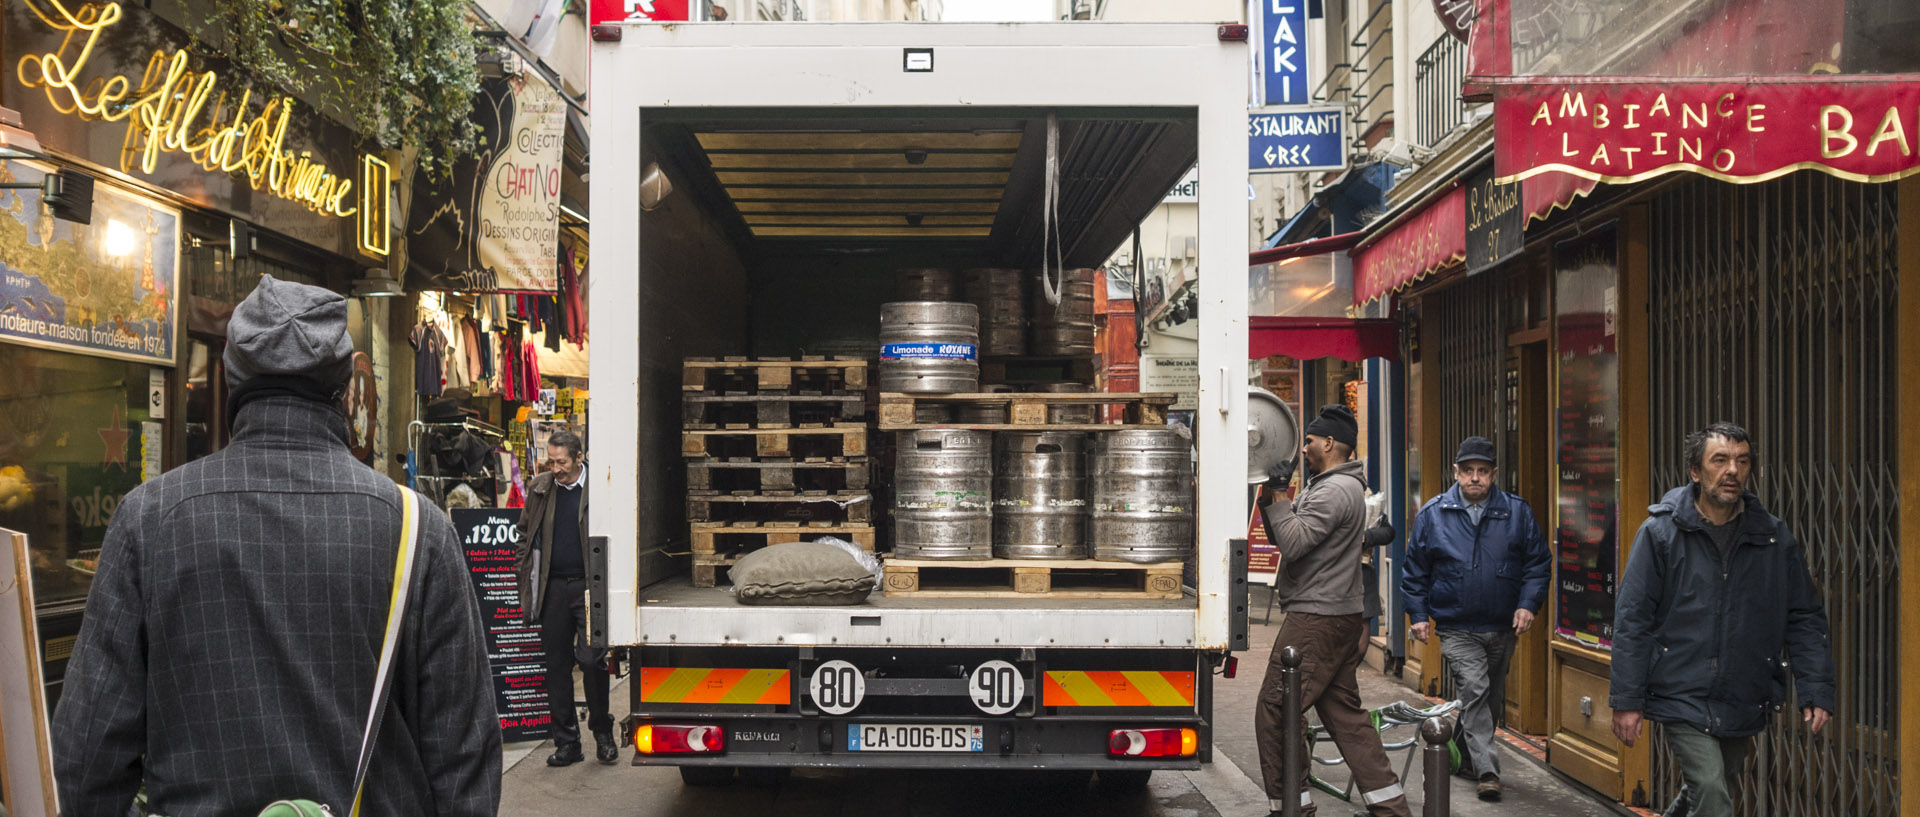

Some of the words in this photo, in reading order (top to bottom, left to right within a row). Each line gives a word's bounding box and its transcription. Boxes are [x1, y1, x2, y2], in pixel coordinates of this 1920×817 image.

[1531, 92, 1766, 132] AMBIANCE
[1820, 104, 1920, 159] BA
[1263, 144, 1311, 166] GREC
[1562, 131, 1736, 172] LATINO
[1469, 187, 1481, 232] Le
[483, 218, 520, 240] DESSINS
[523, 226, 558, 243] ORIGIN
[0, 313, 46, 335] notaure
[49, 322, 89, 342] maison
[128, 338, 140, 350] en
[144, 335, 166, 353] 1974
[892, 345, 934, 354] Limonade
[939, 344, 972, 355] ROXANE
[488, 516, 510, 524] Menu
[465, 535, 471, 544] à
[472, 524, 519, 546] 12,00
[818, 667, 856, 708] 80
[977, 667, 1015, 708] 90
[500, 718, 519, 729] Bon
[520, 714, 552, 728] Appétit
[864, 727, 967, 748] CA-006-DS
[971, 738, 983, 750] 75
